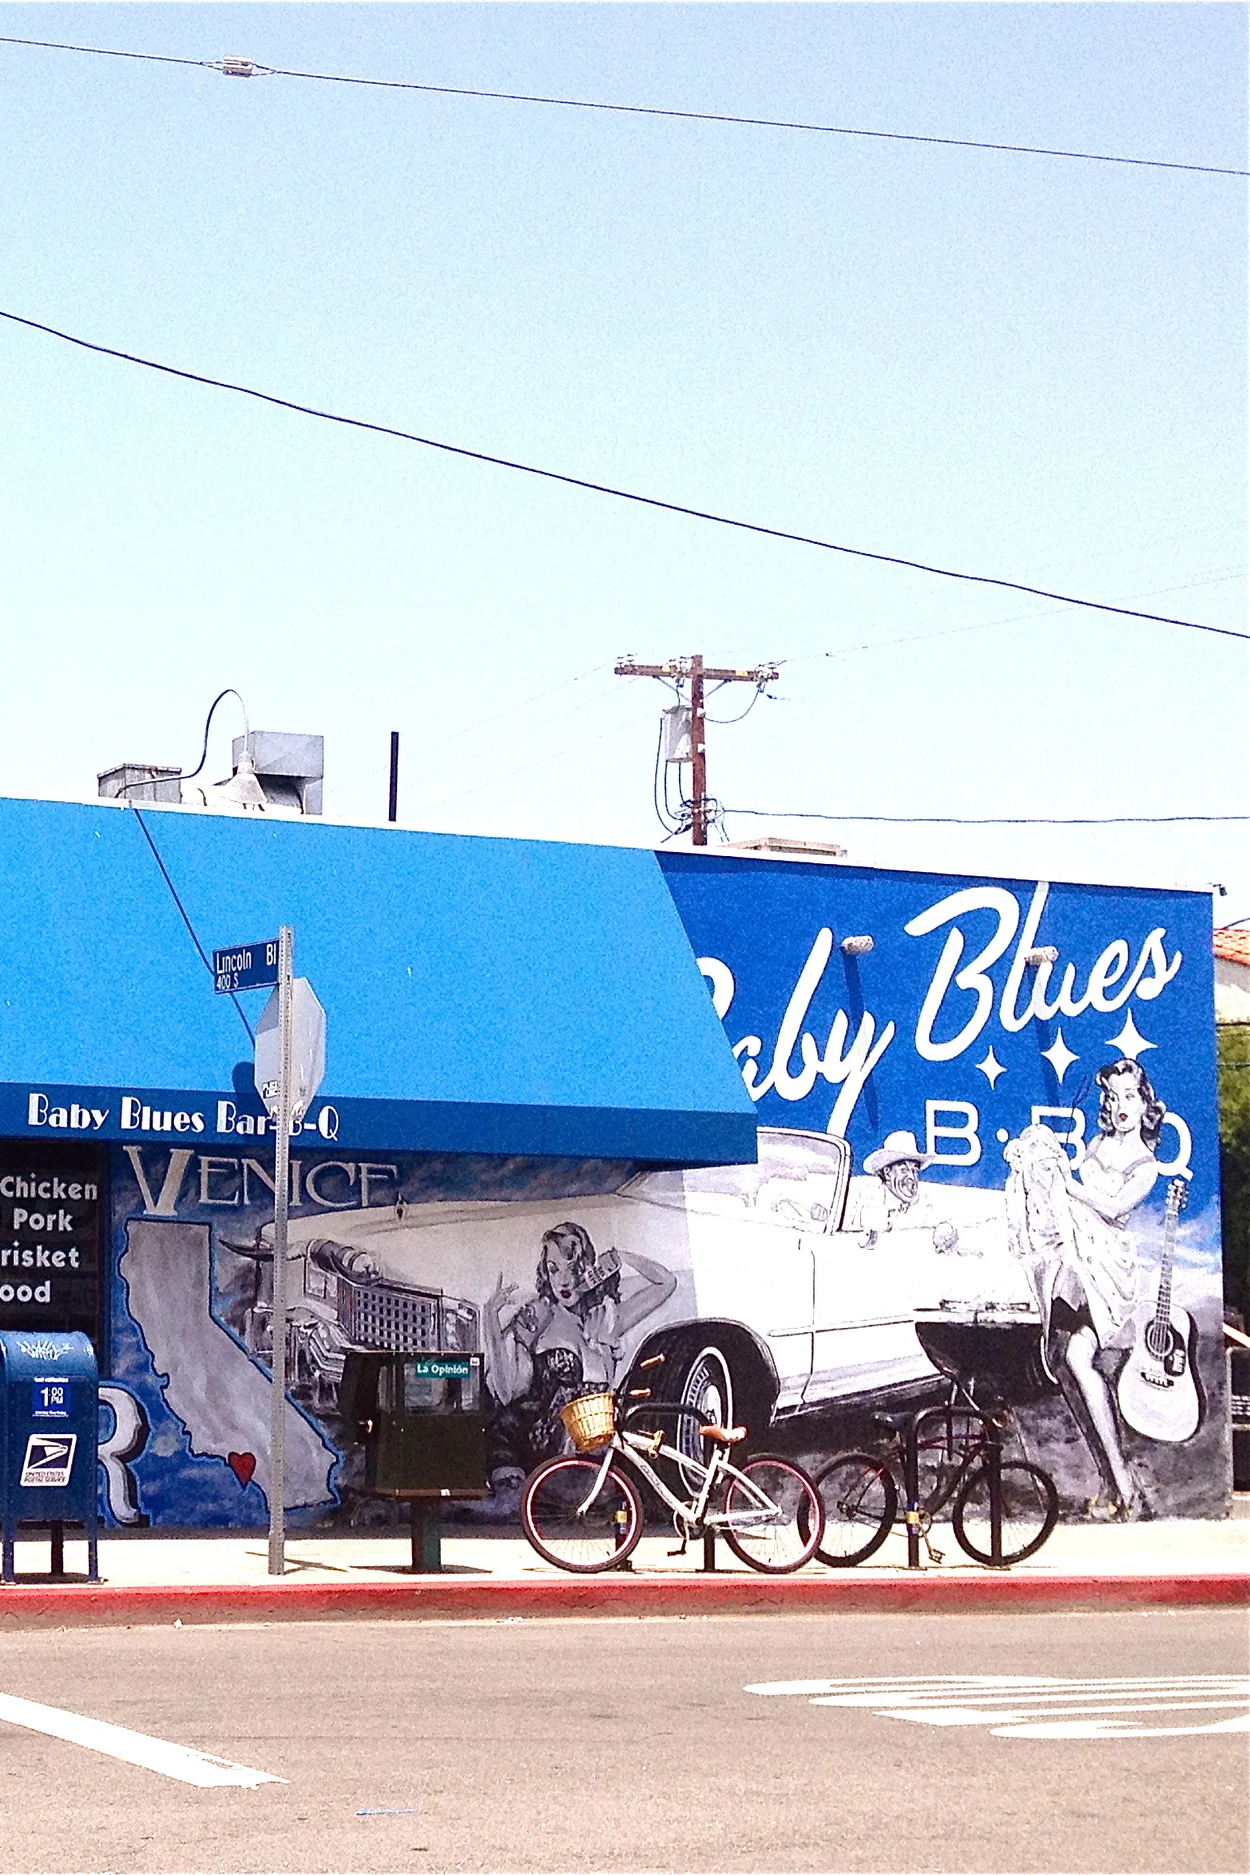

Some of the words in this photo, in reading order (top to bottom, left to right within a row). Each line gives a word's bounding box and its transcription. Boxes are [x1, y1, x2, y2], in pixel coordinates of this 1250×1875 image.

[216, 949, 252, 974] Lincoln
[266, 943, 277, 966] Bl
[216, 974, 231, 990] 400
[233, 972, 239, 989] S
[697, 926, 896, 1136] aby
[903, 881, 1182, 1061] Blues
[28, 1092, 109, 1130] Baby
[120, 1096, 205, 1134] Blues
[0, 1172, 98, 1200] Chicken
[13, 1208, 73, 1231] Pork
[417, 1364, 429, 1374] La
